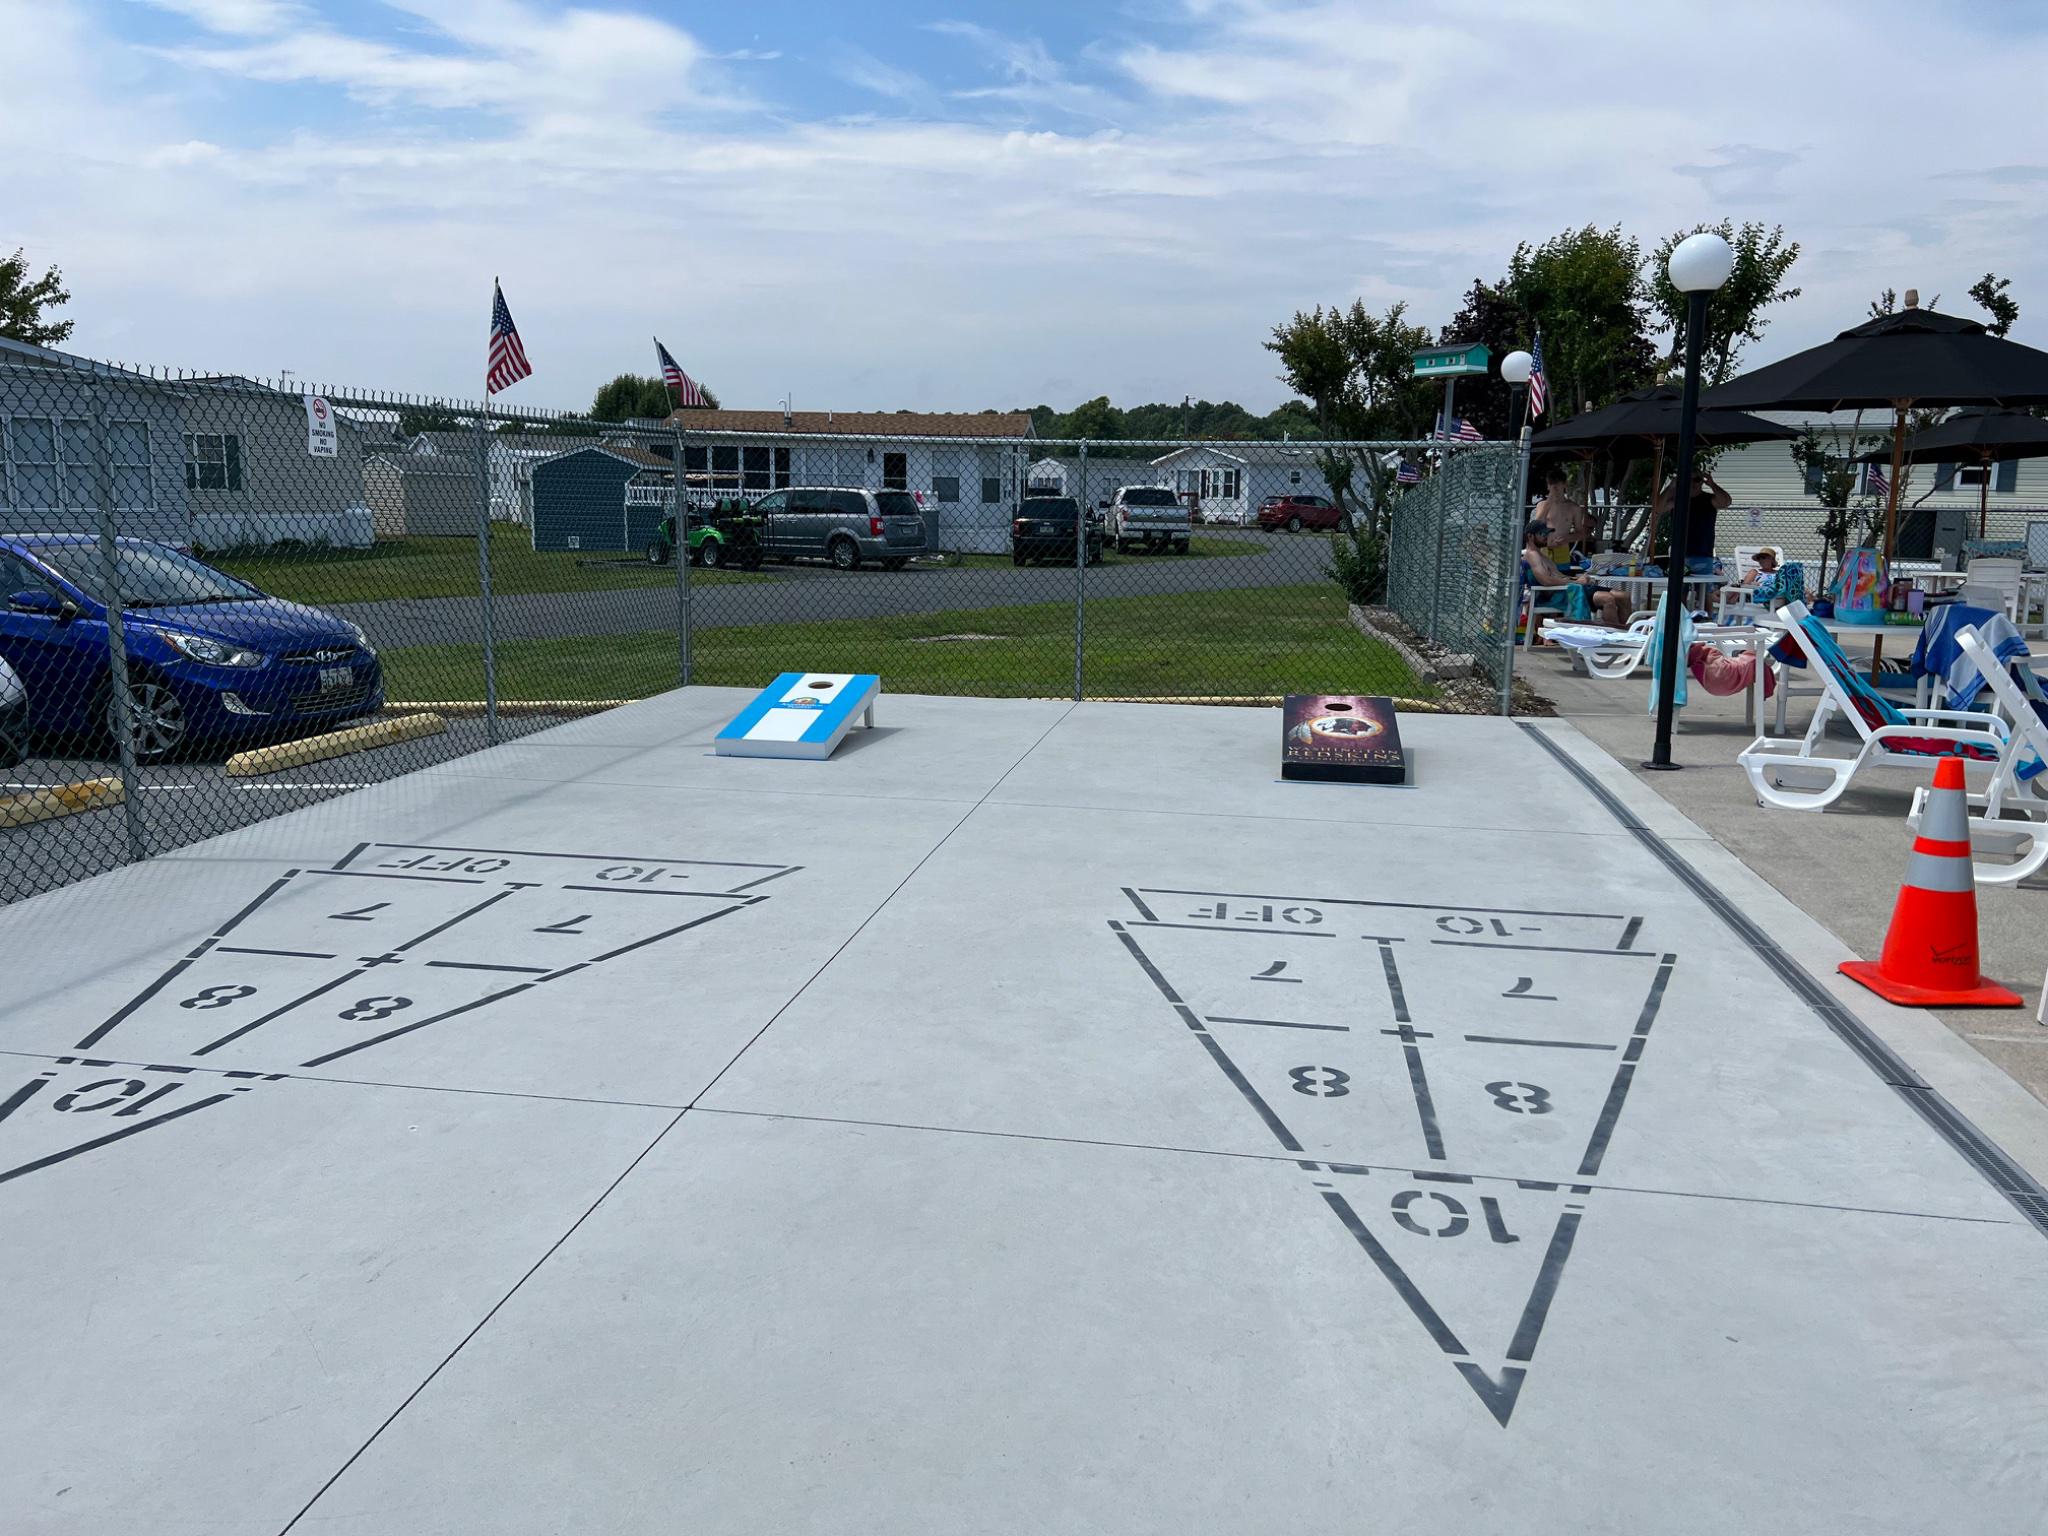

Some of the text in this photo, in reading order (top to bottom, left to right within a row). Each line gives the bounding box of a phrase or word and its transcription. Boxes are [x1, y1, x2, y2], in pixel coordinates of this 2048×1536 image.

[312, 429, 334, 438] SMOKING
[318, 421, 326, 429] NO
[314, 446, 332, 454] VAPING
[320, 438, 327, 446] NO
[1288, 746, 1398, 755] WASHINGTON
[1288, 750, 1400, 760] REDSKINS
[377, 856, 510, 873] OFF
[327, 903, 392, 921] 7
[1188, 903, 1323, 924] OFF
[532, 915, 592, 934] 7
[1250, 961, 1303, 983] 7
[179, 985, 257, 1009] 8
[1502, 977, 1558, 1001] 7
[338, 996, 413, 1021] 8
[1288, 1066, 1350, 1097] 8
[53, 1079, 184, 1117] 10
[1485, 1081, 1553, 1114] 8
[1391, 1191, 1520, 1244] 10
